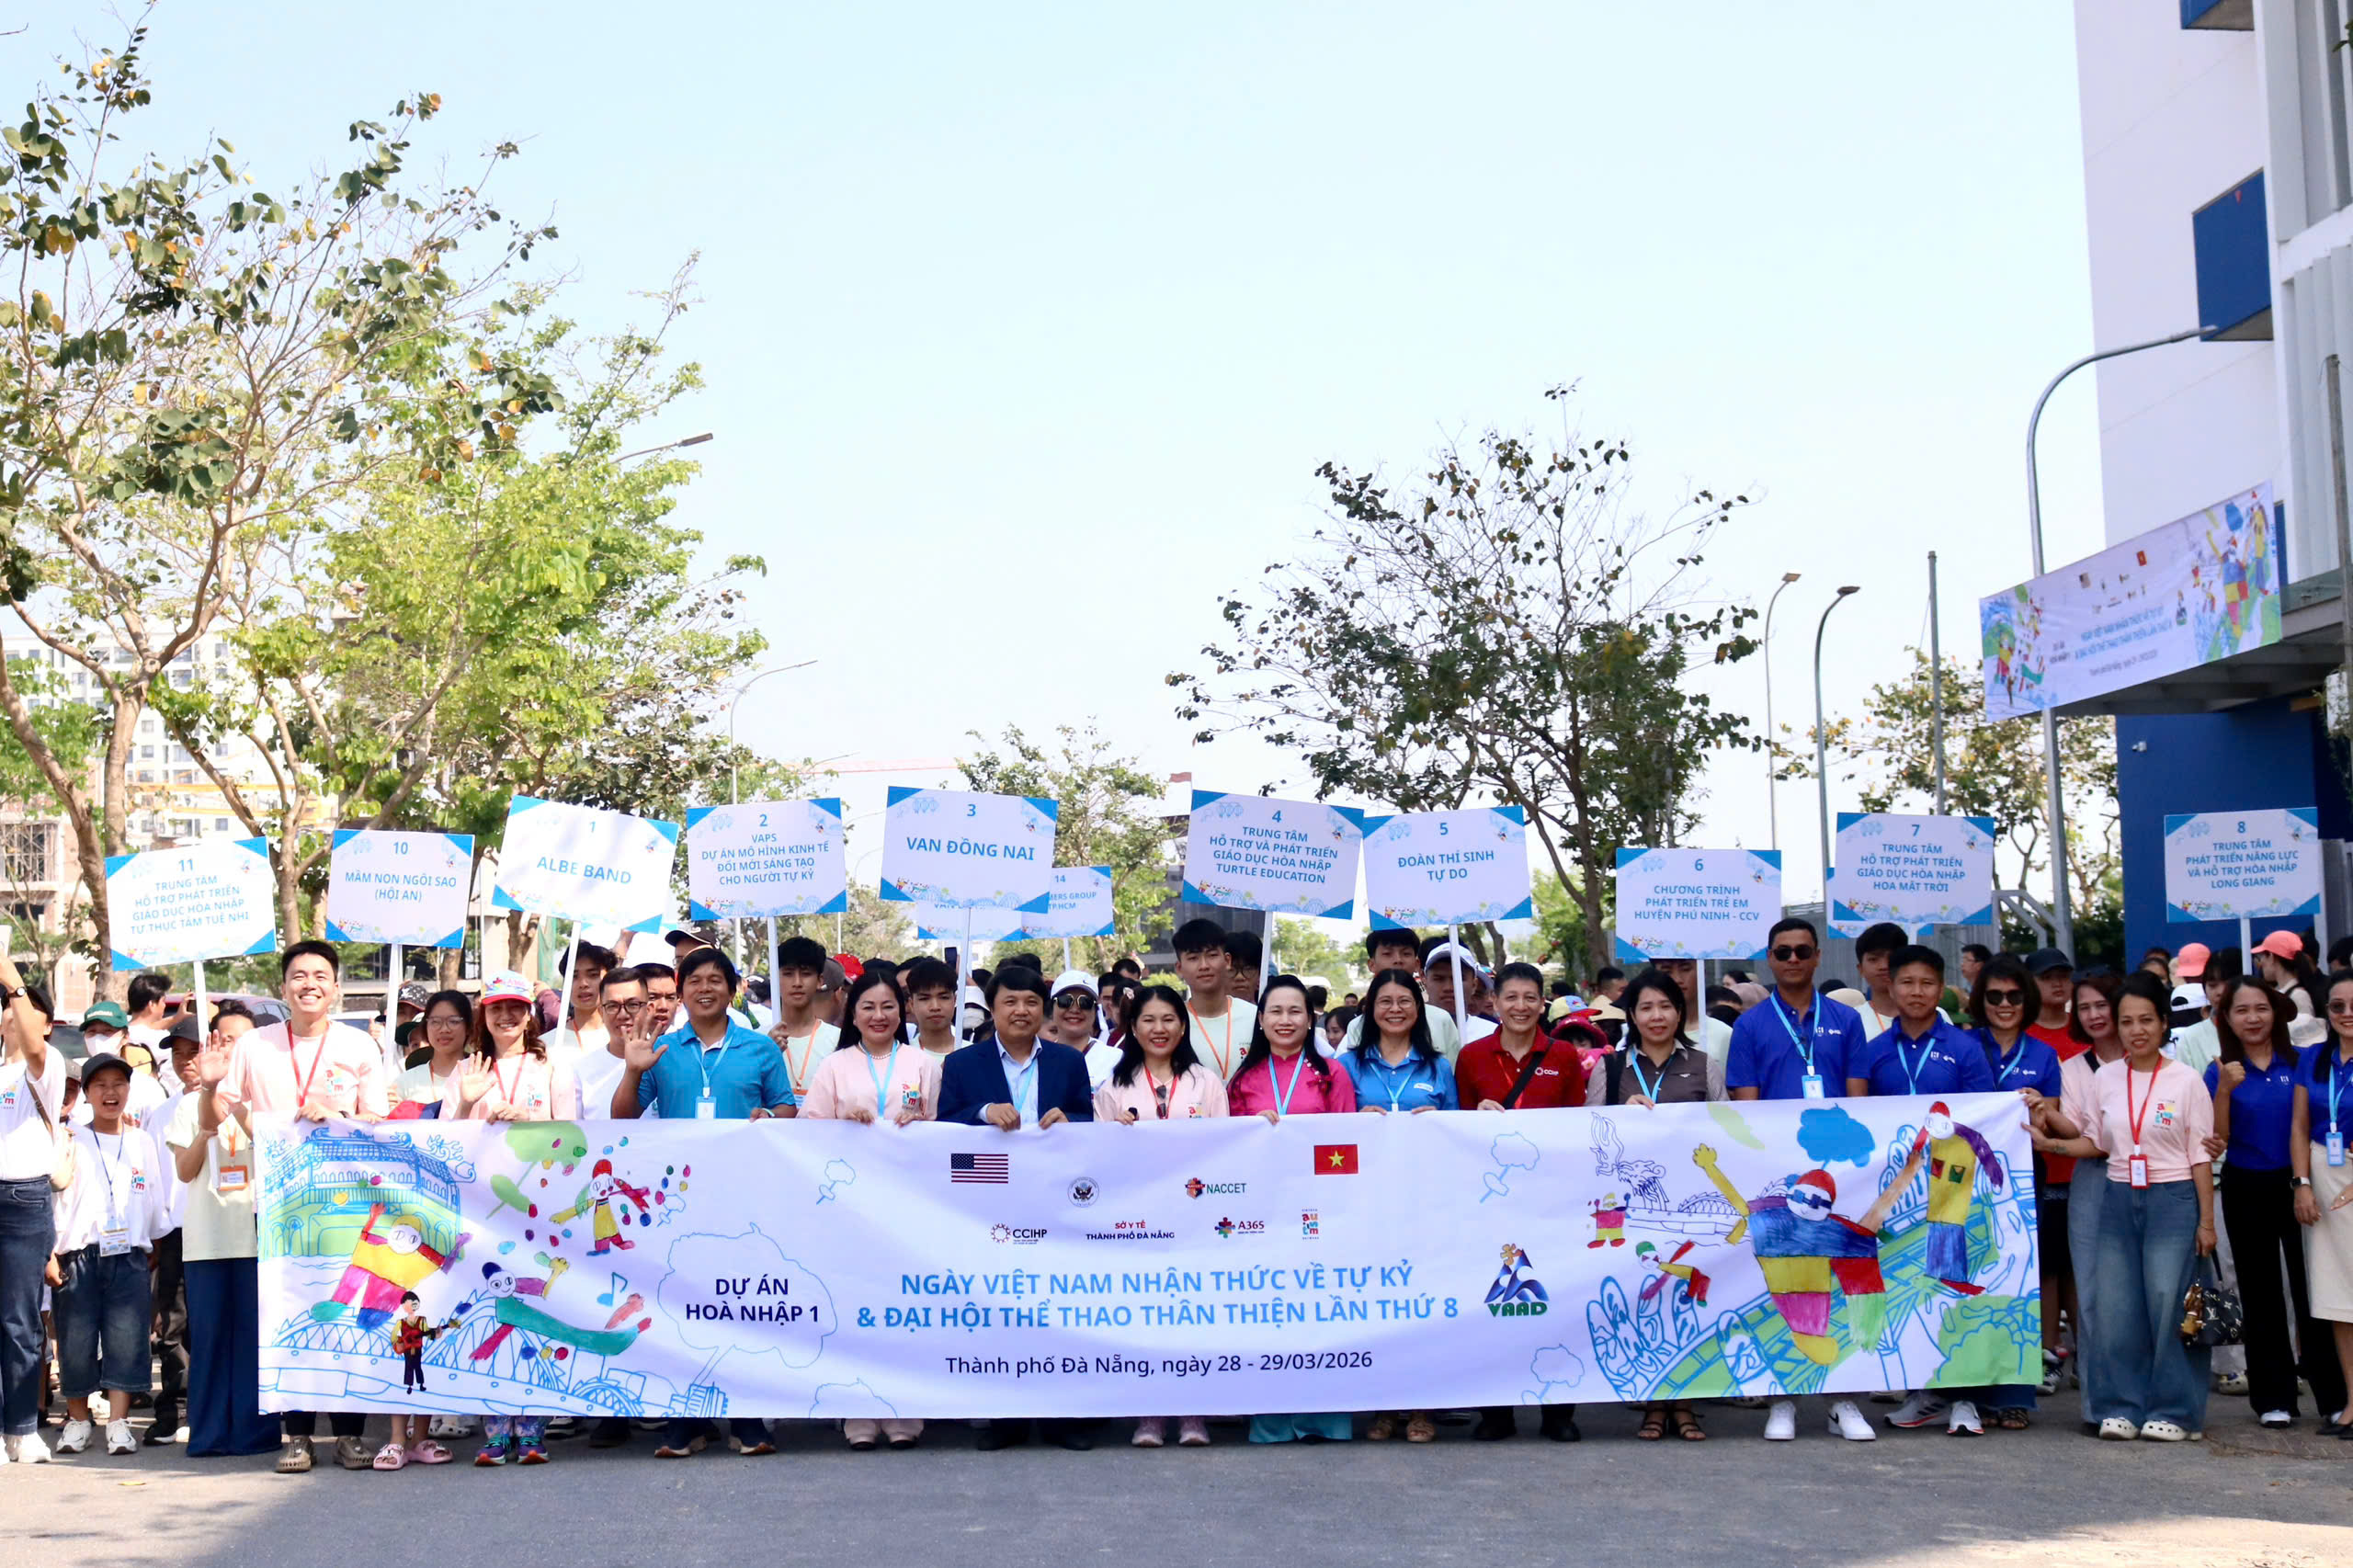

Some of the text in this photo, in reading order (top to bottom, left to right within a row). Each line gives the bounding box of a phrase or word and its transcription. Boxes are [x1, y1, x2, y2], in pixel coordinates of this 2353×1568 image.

[967, 803, 976, 817] 3
[1272, 810, 1281, 823] 4
[759, 813, 768, 827] 2
[589, 821, 597, 833] 1
[1439, 823, 1449, 835] 5
[1912, 824, 1920, 836] 7
[2238, 821, 2245, 834] 8
[751, 833, 778, 844] VAPS
[1243, 826, 1308, 842] TRUNG TÂM
[393, 842, 408, 855] 10
[701, 840, 829, 862] DỰ ÁN MÔ HÌNH KINH TẾ
[906, 836, 1035, 860] VAN ĐỒNG NAI
[1230, 837, 1253, 850] TRỢ
[1256, 839, 1269, 851] VÀ
[1273, 842, 1302, 855] PHÁT
[1882, 843, 1942, 854] TRUNG TÂM
[2213, 838, 2272, 851] TRUNG TÂM
[178, 858, 194, 871] 11
[739, 858, 760, 870] MỚI
[764, 857, 791, 869] SÁNG
[795, 857, 815, 869] TẠO
[1213, 848, 1332, 873] GIÁO DỤC HÒA NHẬP
[1398, 850, 1495, 868] ĐOÀN THÍ SINH
[1695, 858, 1704, 871] 6
[1880, 856, 1901, 866] TRỢ
[1904, 856, 1929, 866] PHÁT
[2186, 854, 2211, 866] PHÁT
[2279, 850, 2299, 863] LỰC
[537, 857, 631, 884] ALBE BAND
[1216, 863, 1325, 883] TURTLE EDUCATION
[1427, 869, 1468, 882] TỰ DO
[1857, 867, 1883, 878] GIÁO
[1886, 869, 1908, 880] DỤC
[1911, 869, 1934, 879] HÒA
[2188, 866, 2200, 877] VÀ
[2222, 867, 2243, 877] TRỢ
[2245, 864, 2267, 874] HÒA
[374, 873, 400, 884] NON
[403, 873, 432, 886] NGÔI
[435, 877, 457, 888] SAO
[720, 874, 741, 886] CHO
[744, 870, 780, 883] NGƯỜI
[784, 870, 798, 883] TỰ
[2211, 877, 2275, 889] LONG GIANG
[1654, 883, 1740, 894] CHƯƠNG TRÌNH
[1873, 881, 1896, 891] HOA
[375, 887, 423, 903] (HỘI AN)
[1069, 892, 1097, 900] GROUP
[1645, 896, 1672, 907] PHÁT
[1711, 896, 1729, 908] TRẺ
[1733, 899, 1748, 908] EM
[1634, 910, 1672, 922] HUYỆN
[1675, 908, 1698, 920] PHÚ
[1700, 911, 1730, 920] NINH
[1740, 912, 1759, 921] CCV
[1207, 1183, 1246, 1194] NACCET
[1115, 1221, 1126, 1229] SỞ
[1238, 1221, 1265, 1230] A365
[1013, 1229, 1047, 1238] CCIHP
[901, 1259, 1413, 1299] NGÀY VIỆT NAM NHẬN THỨC VỀ TỰ KỶ
[715, 1274, 789, 1300] DỰ ÁN
[686, 1301, 818, 1326] HOÀ NHẬP 1
[857, 1293, 1458, 1332] & ĐẠI HỘI THỂ THAO THÂN THIỆN LẦN THỨ 8
[1487, 1301, 1547, 1317] VAAD
[946, 1356, 1009, 1374] Thành
[1017, 1353, 1054, 1378] phố
[1062, 1355, 1088, 1373] Đà
[1095, 1352, 1155, 1377] Nẵng,
[1162, 1356, 1211, 1378] ngày
[1217, 1356, 1242, 1371] 28
[1260, 1351, 1373, 1371] 29/03/2026
